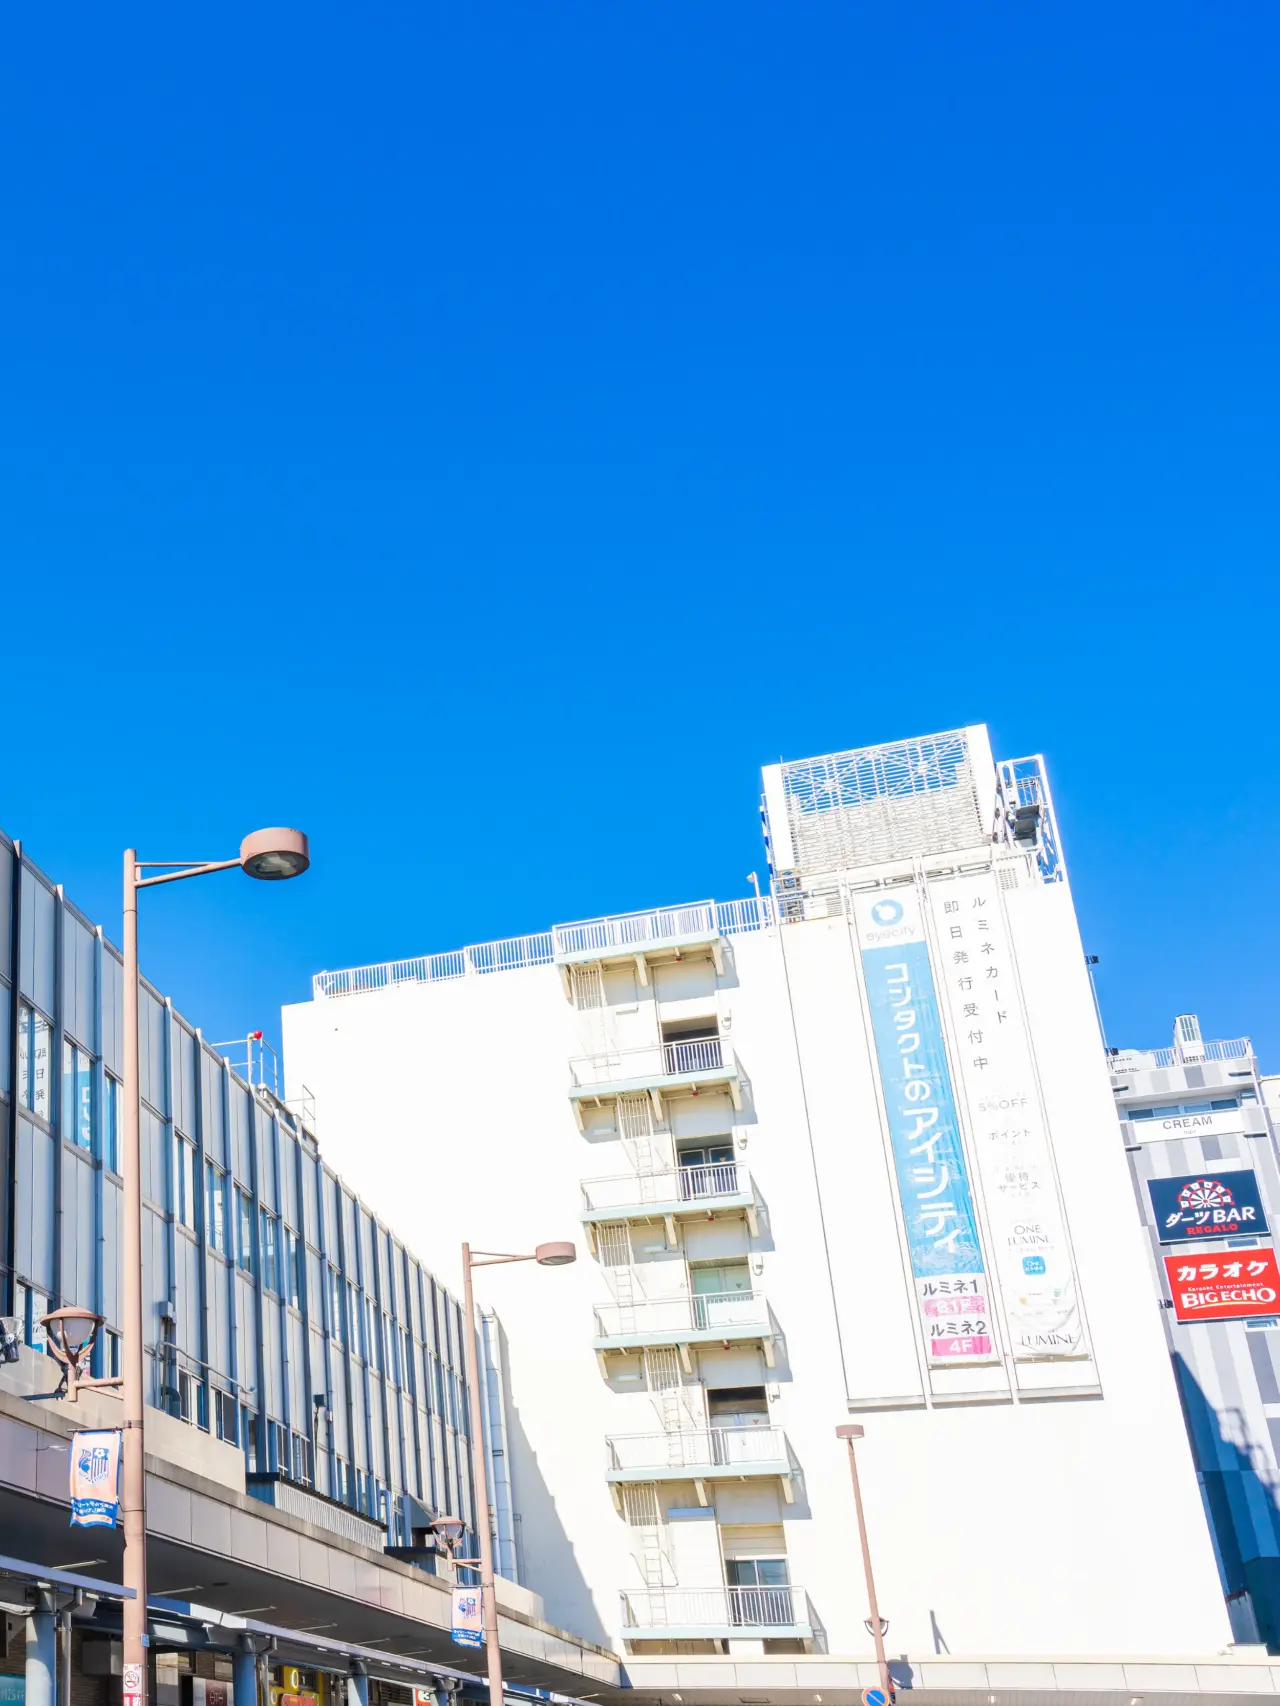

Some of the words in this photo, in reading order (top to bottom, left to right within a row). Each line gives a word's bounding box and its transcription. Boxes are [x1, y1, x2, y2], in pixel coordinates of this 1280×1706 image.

[866, 925, 916, 942] eyecity
[972, 896, 1008, 1024] ルミネカード
[943, 900, 989, 1070] 即日発行受付中
[884, 962, 961, 1254] コンタクトのアイシティ
[1162, 1115, 1213, 1131] CREAM
[997, 1181, 1041, 1193] サービス
[1013, 1224, 1042, 1235] ONE
[1185, 1223, 1239, 1236] REGALO
[1176, 1260, 1269, 1282] カラオケ
[922, 1279, 979, 1297] ルミネ1
[1215, 1282, 1264, 1290] Entertainment
[1180, 1291, 1219, 1309] BIG
[1220, 1287, 1277, 1303] ECHO
[930, 1319, 988, 1338] ルミネ2
[949, 1339, 973, 1355] 4F
[1020, 1333, 1075, 1346] LUMINE
